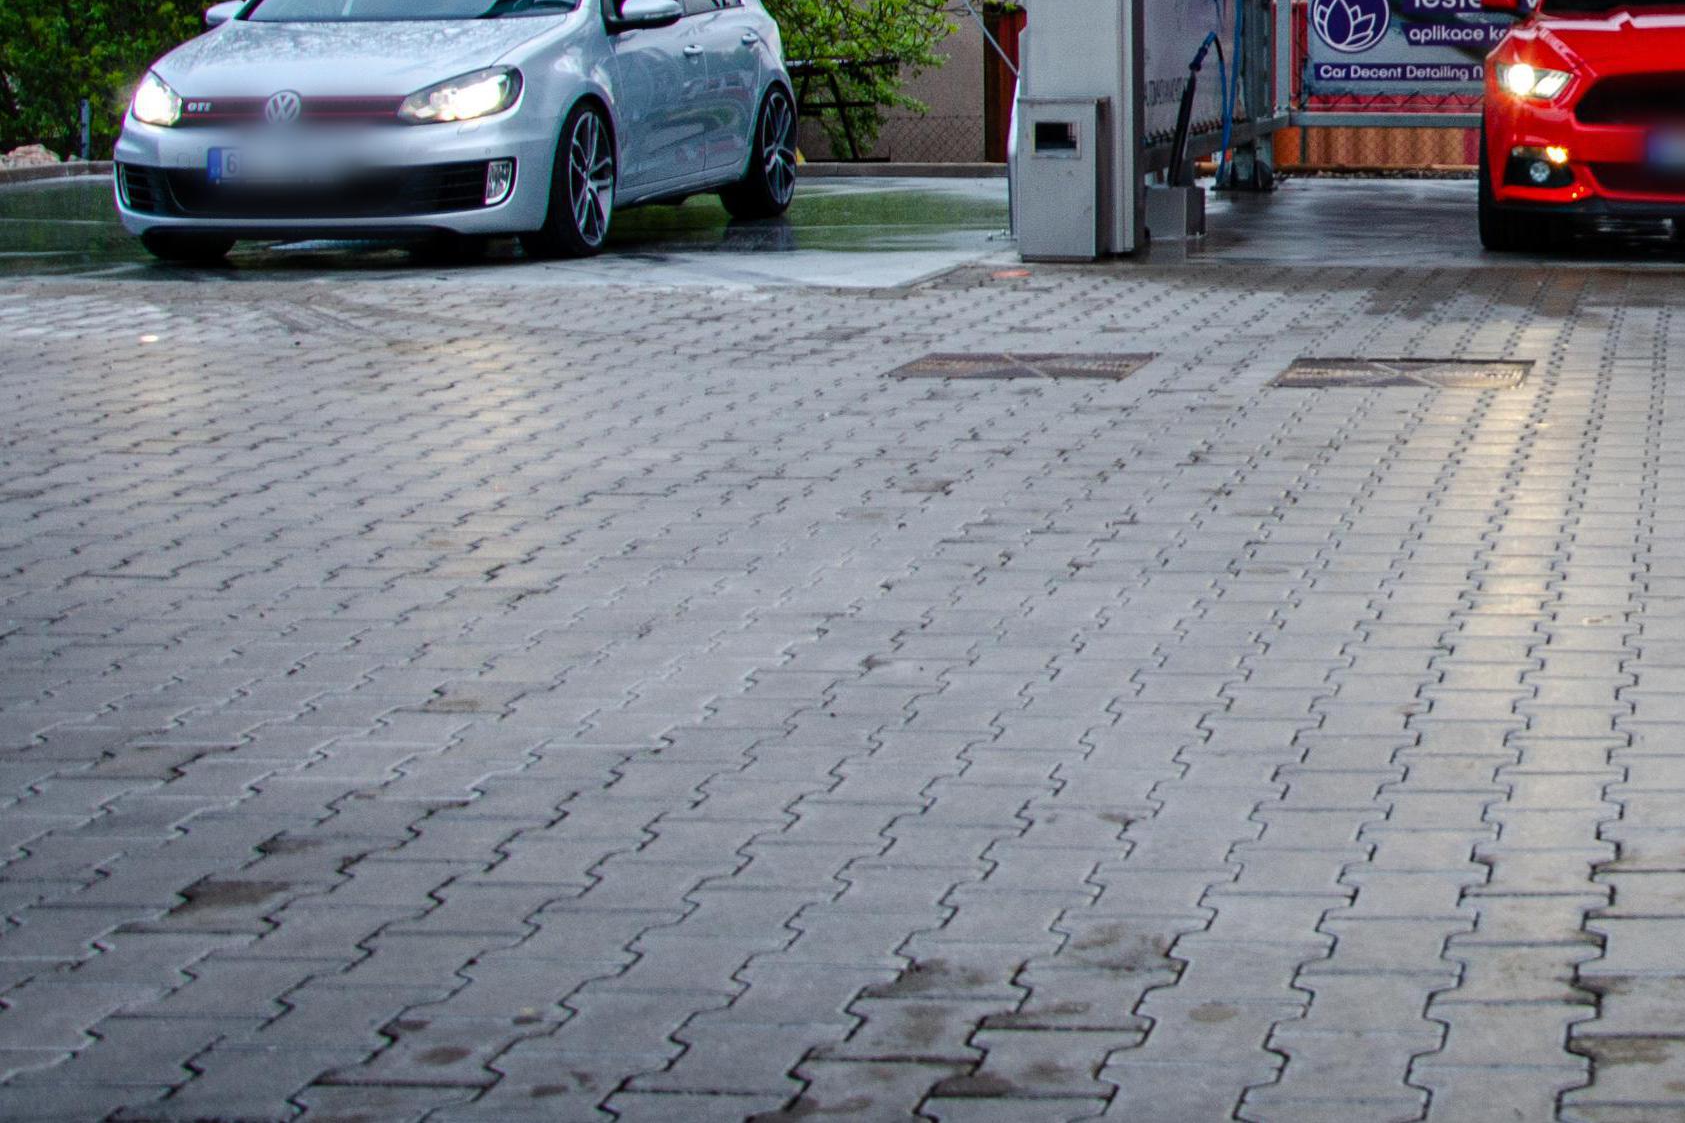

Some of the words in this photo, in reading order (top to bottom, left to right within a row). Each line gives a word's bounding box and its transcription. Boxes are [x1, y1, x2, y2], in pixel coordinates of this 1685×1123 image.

[1409, 26, 1484, 43] aplikace
[1320, 65, 1347, 78] Car
[1350, 65, 1401, 78] Decent
[1406, 65, 1469, 81] Detailing
